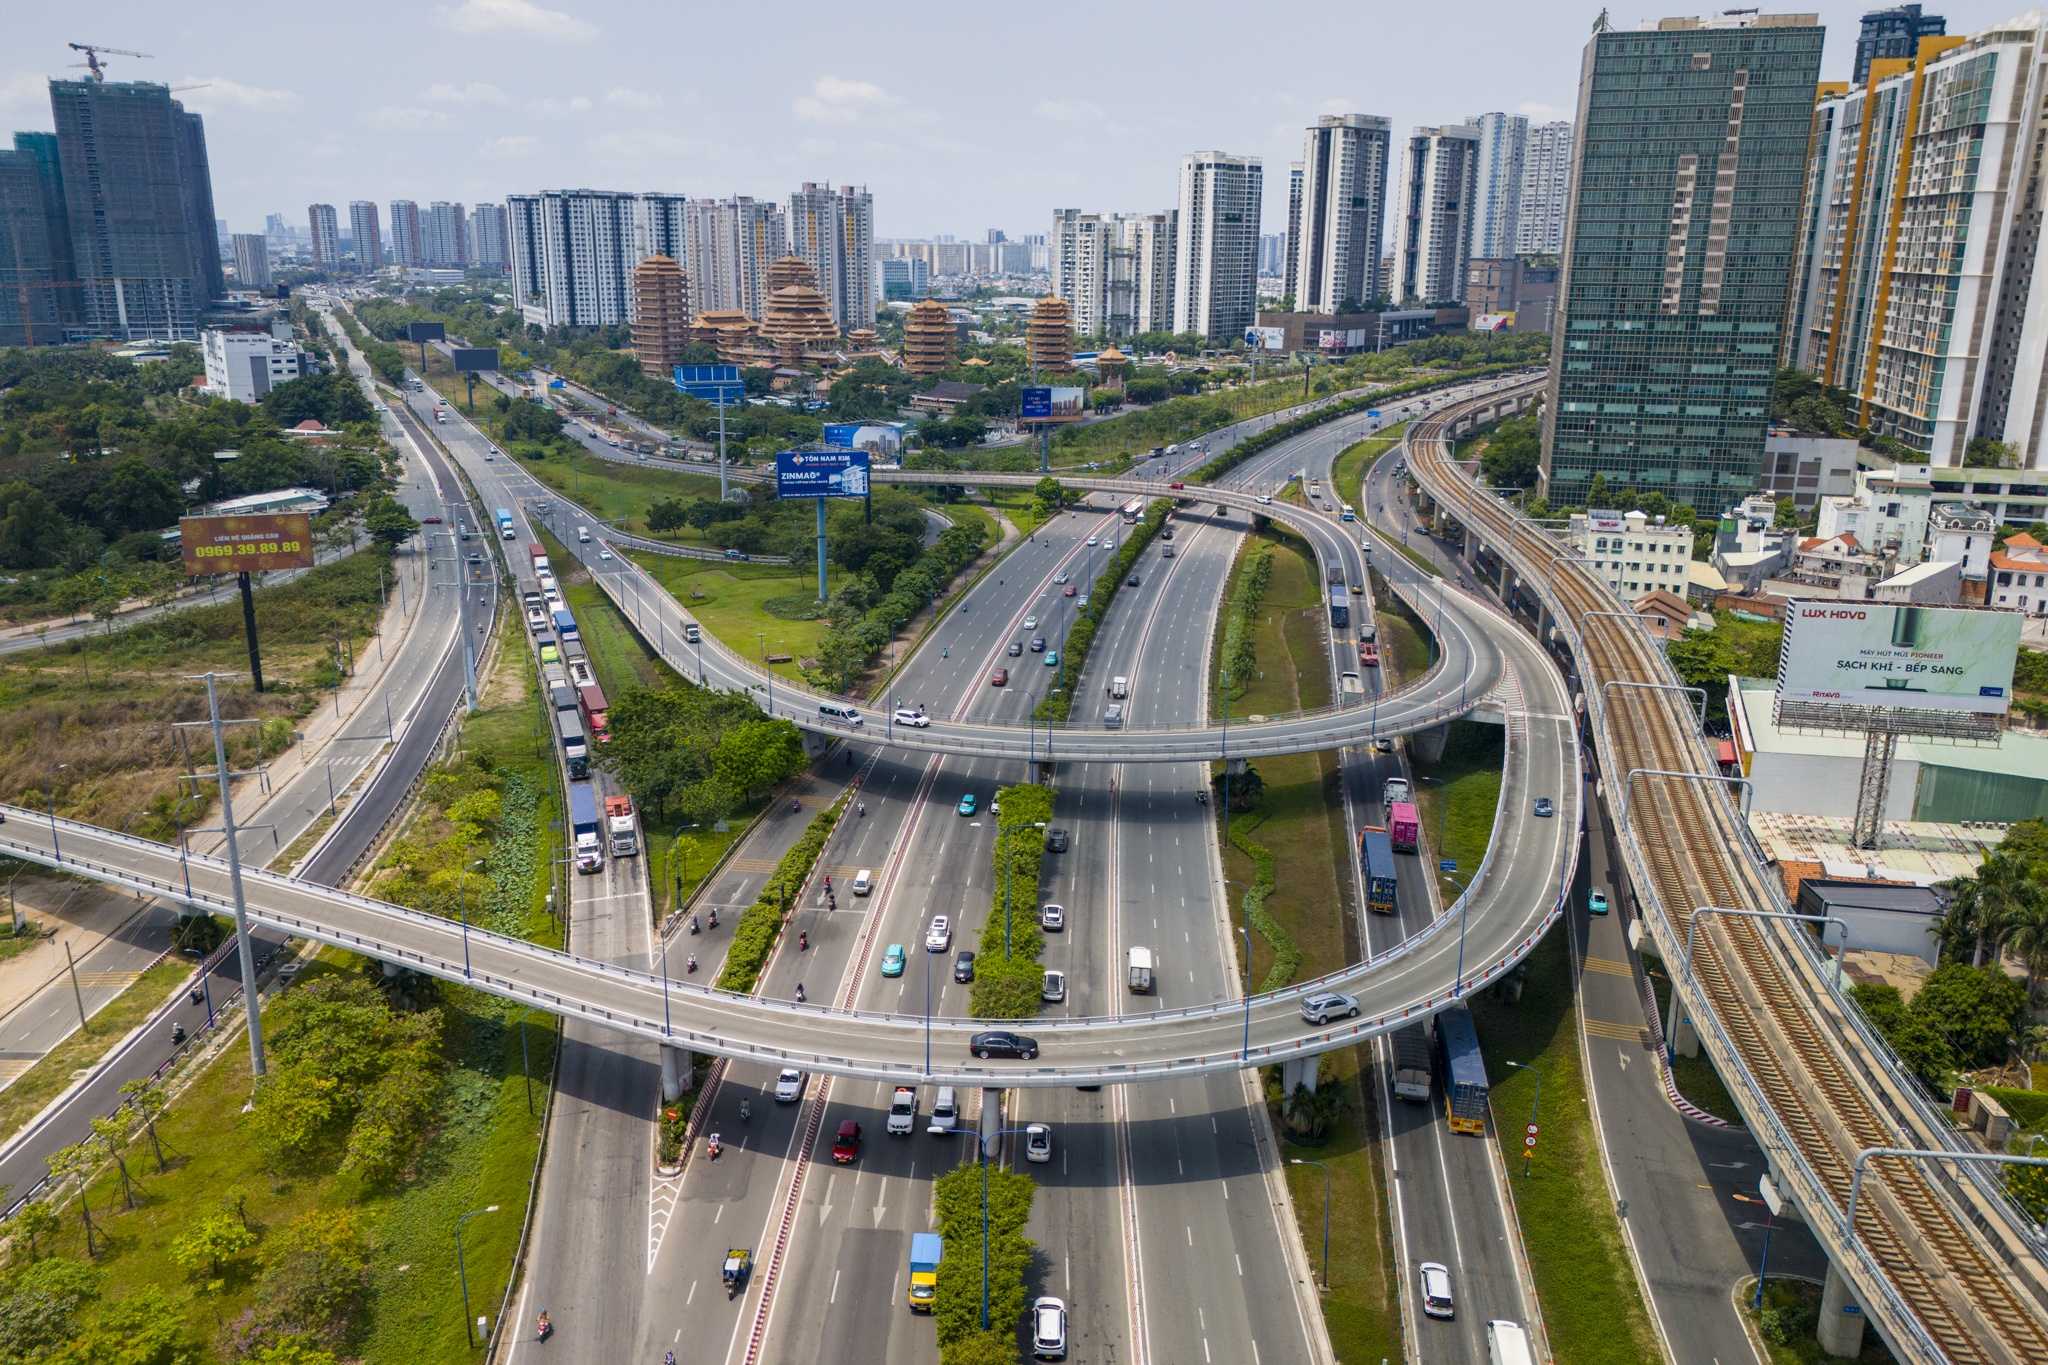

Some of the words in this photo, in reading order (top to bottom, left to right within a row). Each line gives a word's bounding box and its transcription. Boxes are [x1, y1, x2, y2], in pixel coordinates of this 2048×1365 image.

[195, 541, 300, 557] 0969.39.89.89
[1802, 609, 1827, 618] LUX
[1830, 610, 1866, 620] HOVO
[1877, 649, 1891, 657] HÚT
[1837, 660, 1867, 670] SẠCH
[1871, 661, 1893, 671] KHÍ
[1905, 661, 1927, 673] BẾP
[1930, 665, 1964, 675] SANG
